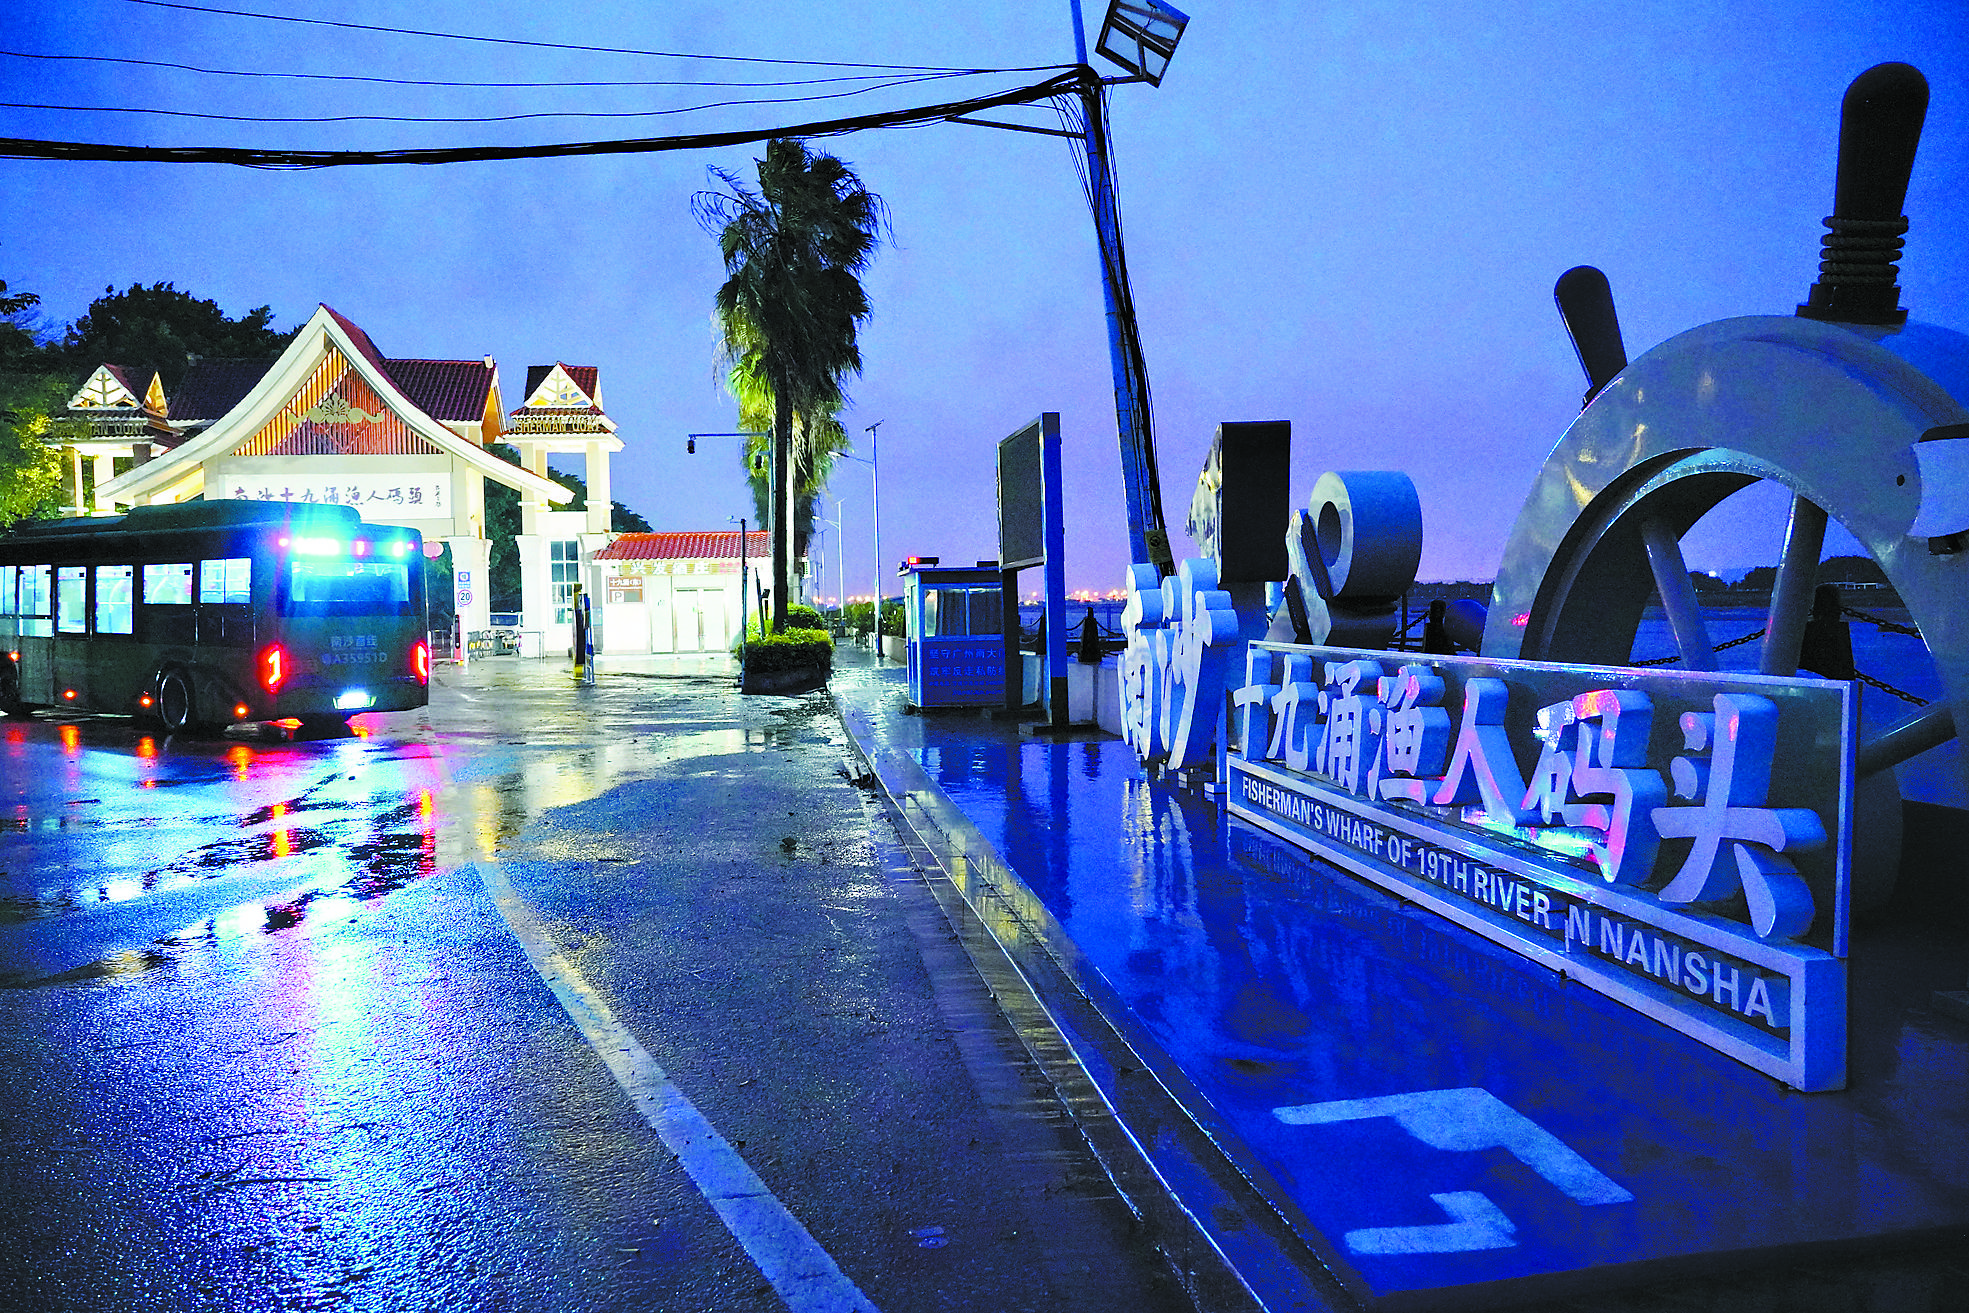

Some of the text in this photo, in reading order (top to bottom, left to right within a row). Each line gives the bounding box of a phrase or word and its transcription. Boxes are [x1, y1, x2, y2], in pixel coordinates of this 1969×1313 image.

[511, 419, 566, 432] ISHERMAN
[460, 592, 471, 601] 20
[614, 591, 622, 602] P
[1233, 648, 1787, 938] 十九涌渔人码头
[1242, 775, 1323, 830] FISHERMAN'S
[1326, 808, 1384, 855] WHARF
[1387, 834, 1412, 868] OF
[1417, 847, 1467, 894] 19TH
[1474, 867, 1550, 930] RIVER
[1600, 916, 1775, 1028] NANSHA
